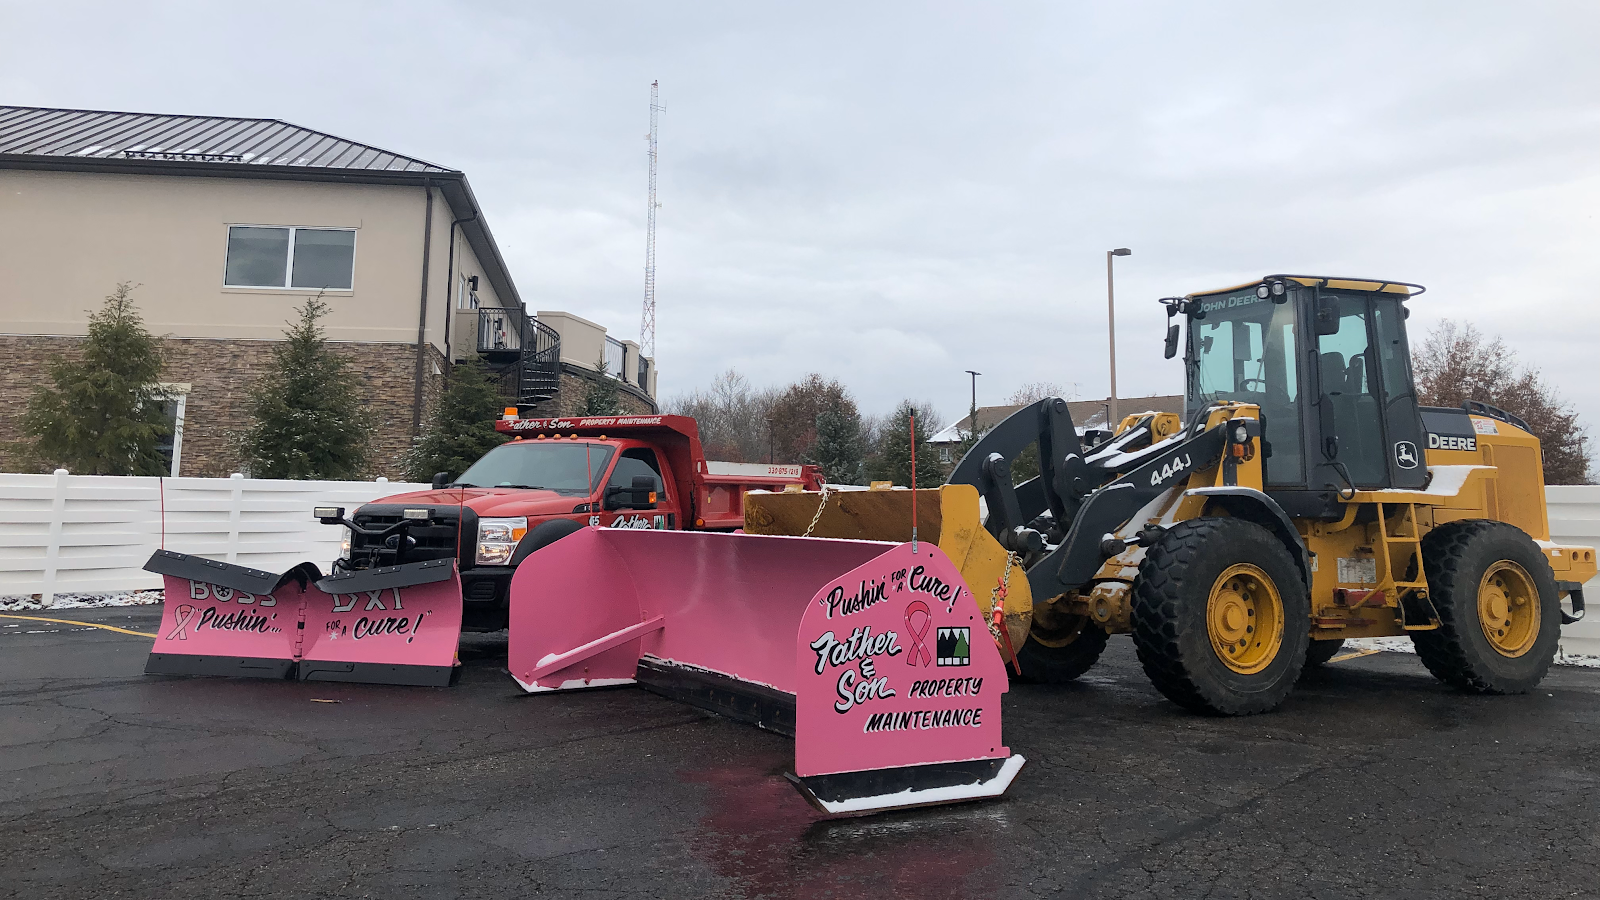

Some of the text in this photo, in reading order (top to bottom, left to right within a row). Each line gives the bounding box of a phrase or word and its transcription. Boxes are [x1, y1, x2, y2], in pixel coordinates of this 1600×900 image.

[1197, 294, 1265, 313] JOHN DEER
[549, 418, 575, 429] Son
[579, 418, 616, 427] PROPERTY
[1428, 433, 1477, 451] DEERE
[1150, 453, 1192, 486] 444J
[610, 513, 652, 529] Fther
[891, 568, 907, 583] FOR
[326, 619, 341, 632] FOR
[341, 625, 347, 637] A
[810, 626, 902, 675] Father
[859, 658, 876, 680] &
[834, 669, 896, 714] Son
[908, 677, 984, 699] PROPERTY
[863, 708, 984, 734] MAINTENANCE
